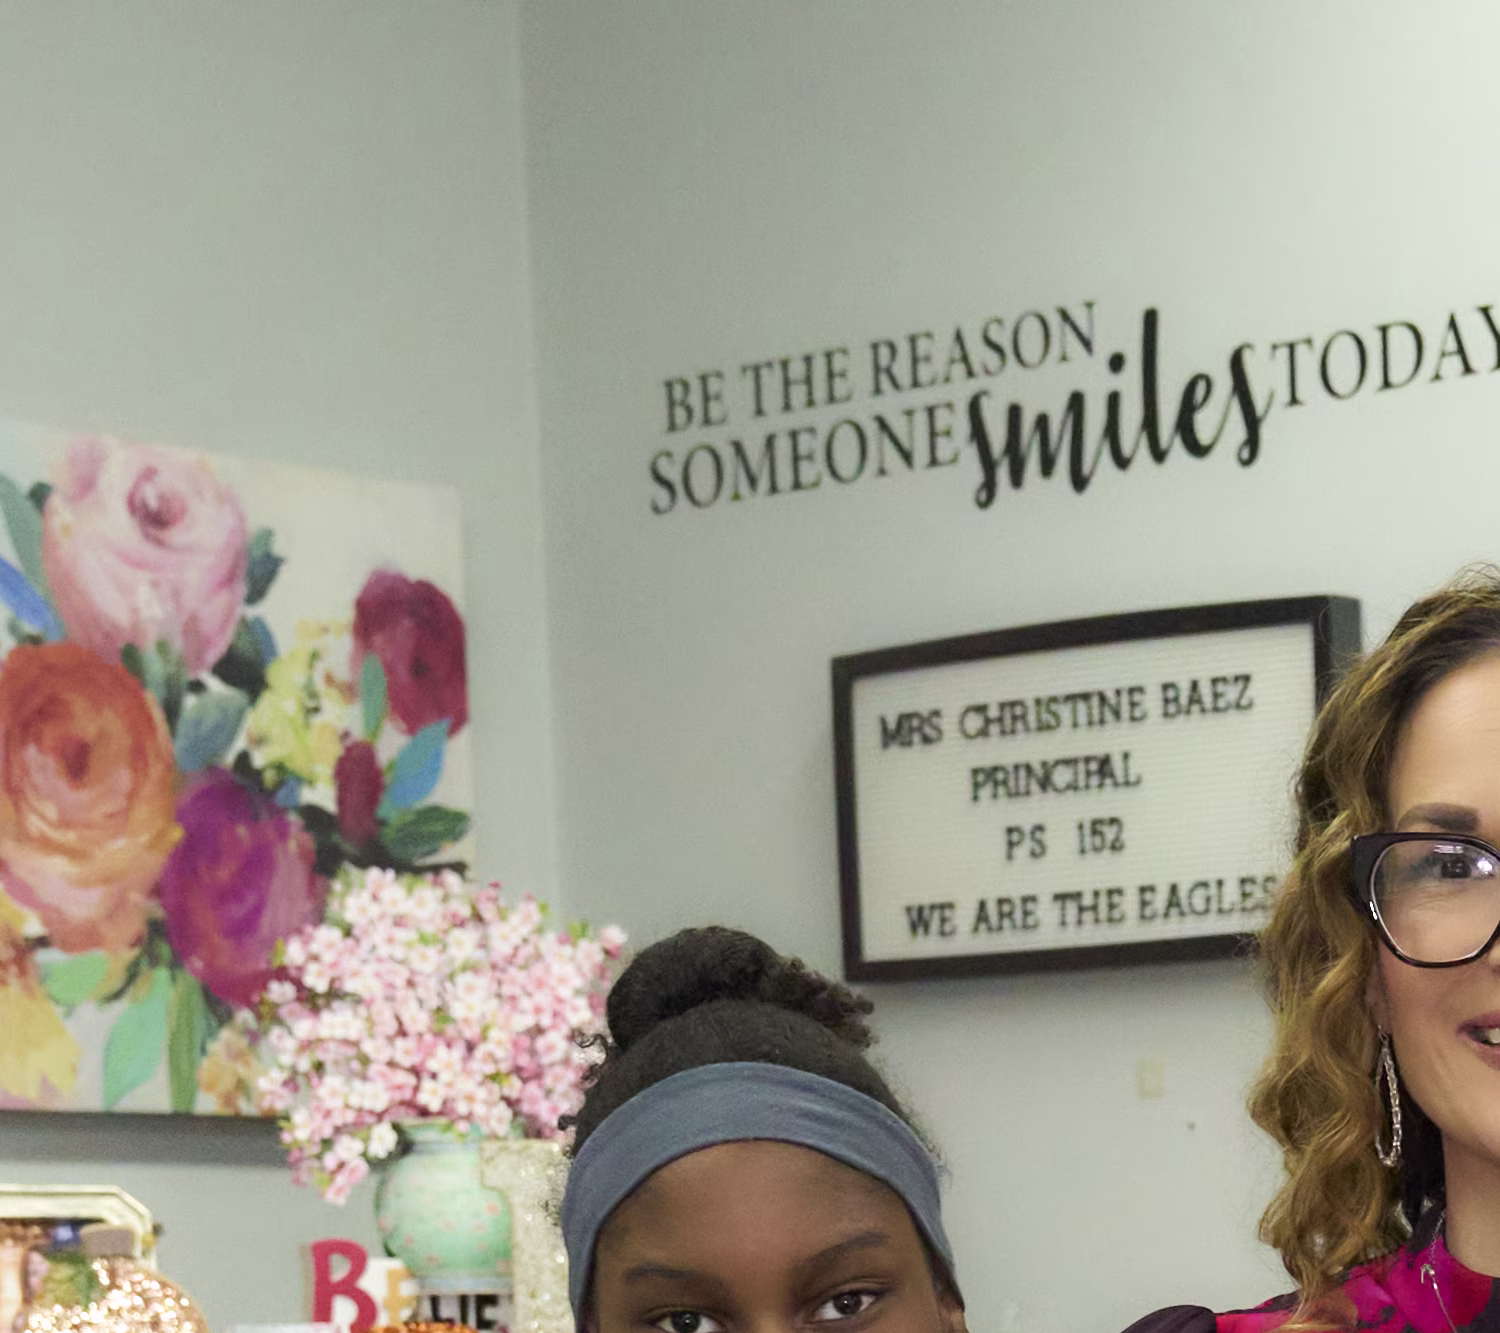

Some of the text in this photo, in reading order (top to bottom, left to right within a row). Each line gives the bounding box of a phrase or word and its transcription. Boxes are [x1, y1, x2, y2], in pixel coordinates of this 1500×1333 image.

[663, 300, 1096, 433] BE THE REASON
[650, 402, 959, 515] SOMEONE
[968, 308, 1274, 509] smiles
[879, 674, 1253, 750] MRS CHRISTINE BAEZ
[971, 751, 1143, 802] PRINCIPAL
[1005, 817, 1126, 861] PS 152
[905, 901, 956, 938] WE
[972, 894, 1040, 934] ARE
[1052, 886, 1126, 928] THE
